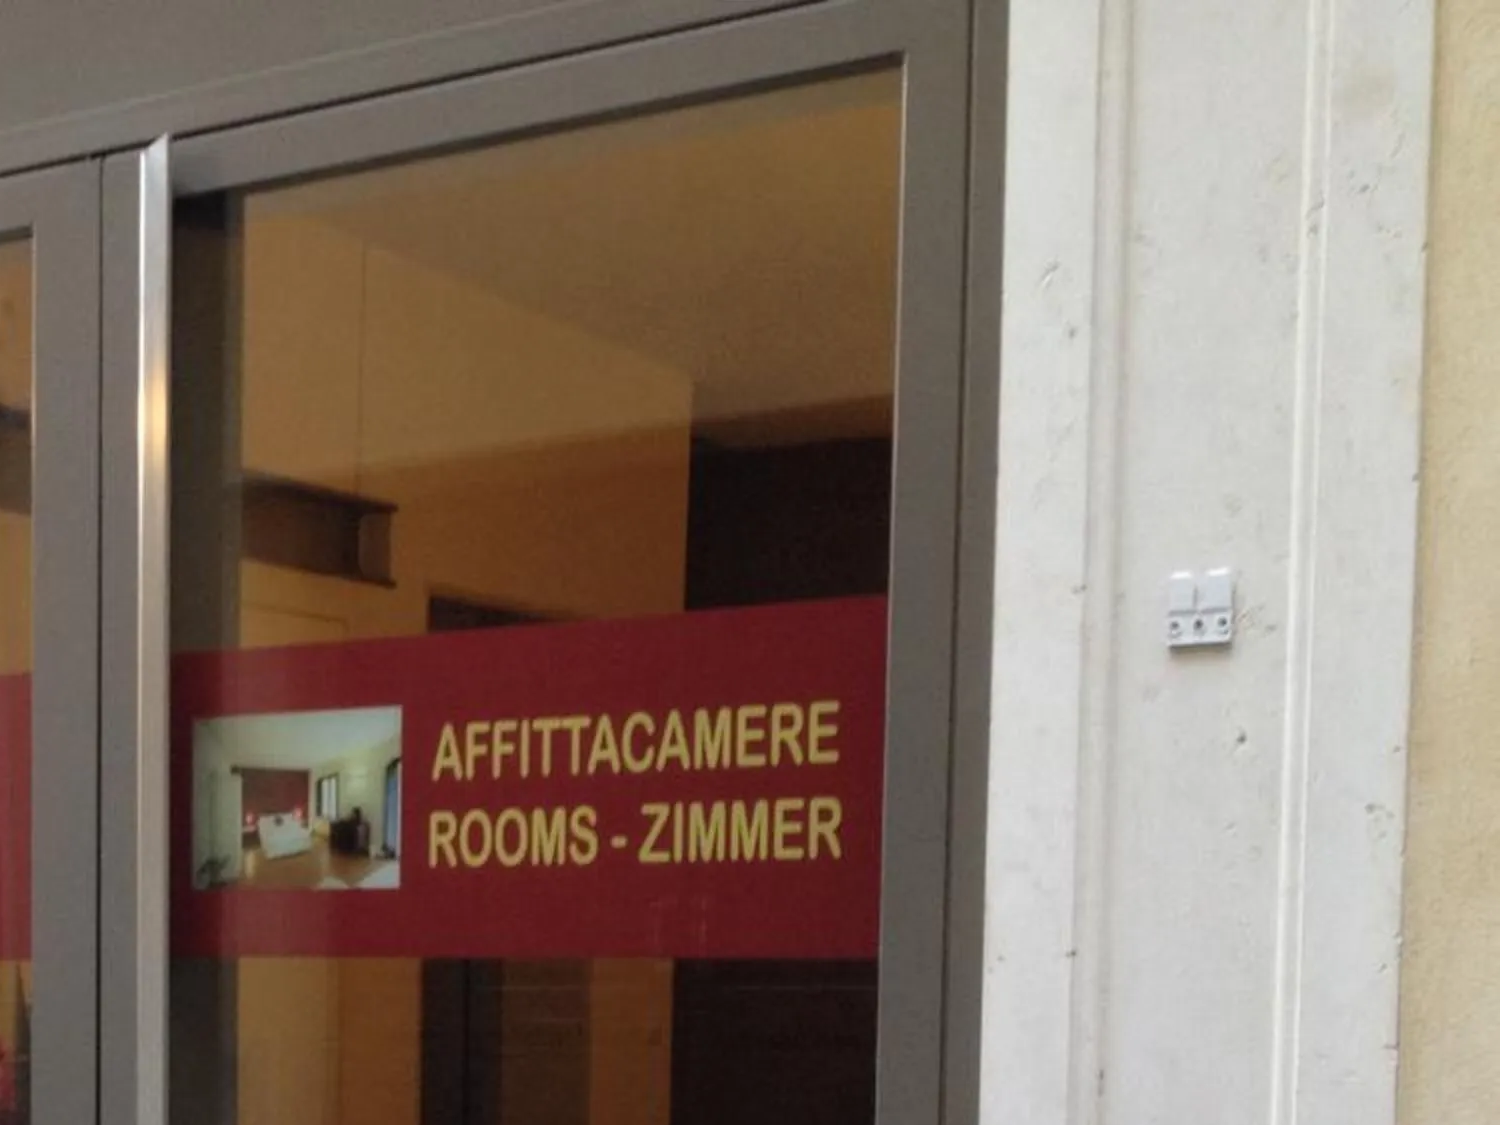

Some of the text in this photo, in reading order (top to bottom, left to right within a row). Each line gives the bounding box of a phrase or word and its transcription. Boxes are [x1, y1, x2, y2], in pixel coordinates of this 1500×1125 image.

[432, 700, 840, 782] AFFITTACAMERE
[428, 804, 599, 868] ROOMS
[638, 796, 843, 864] ZIMMER
